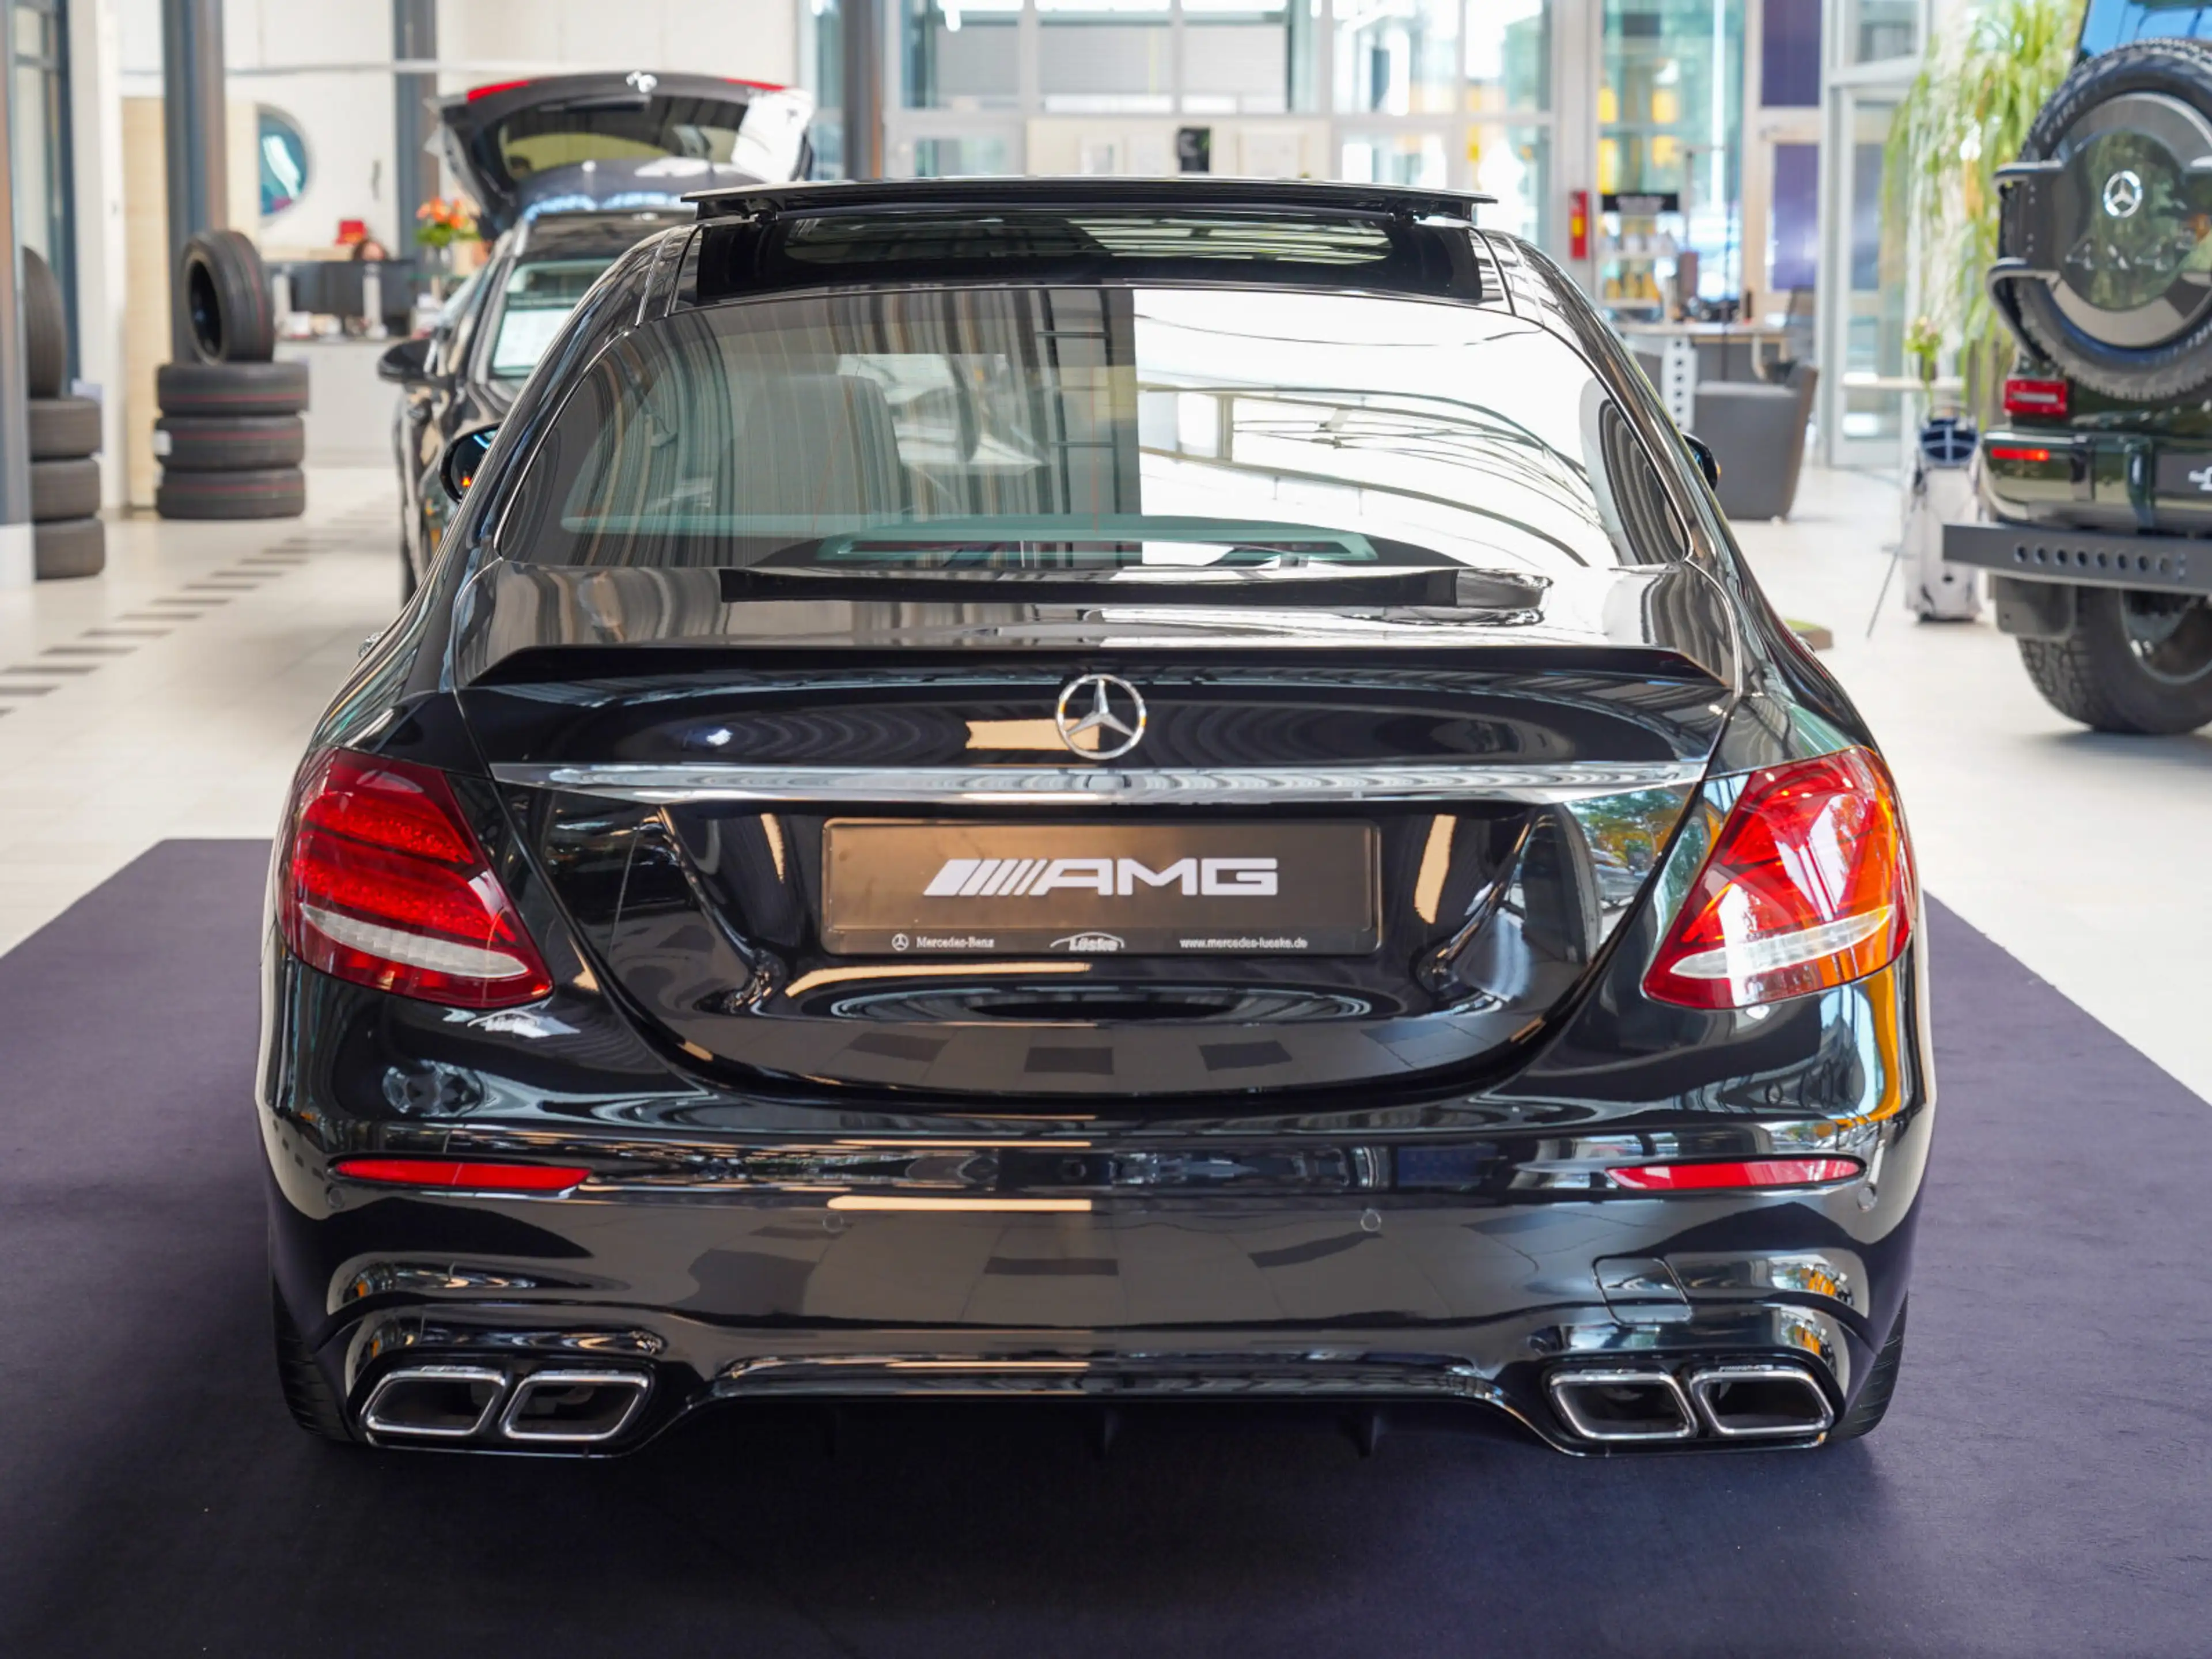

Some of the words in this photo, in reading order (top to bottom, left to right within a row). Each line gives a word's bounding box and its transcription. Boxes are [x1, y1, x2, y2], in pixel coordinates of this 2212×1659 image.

[1029, 858, 1279, 896] AMG
[916, 936, 995, 948] Mercedes-Benz
[1179, 937, 1308, 949] www.mercedes-lueske.de
